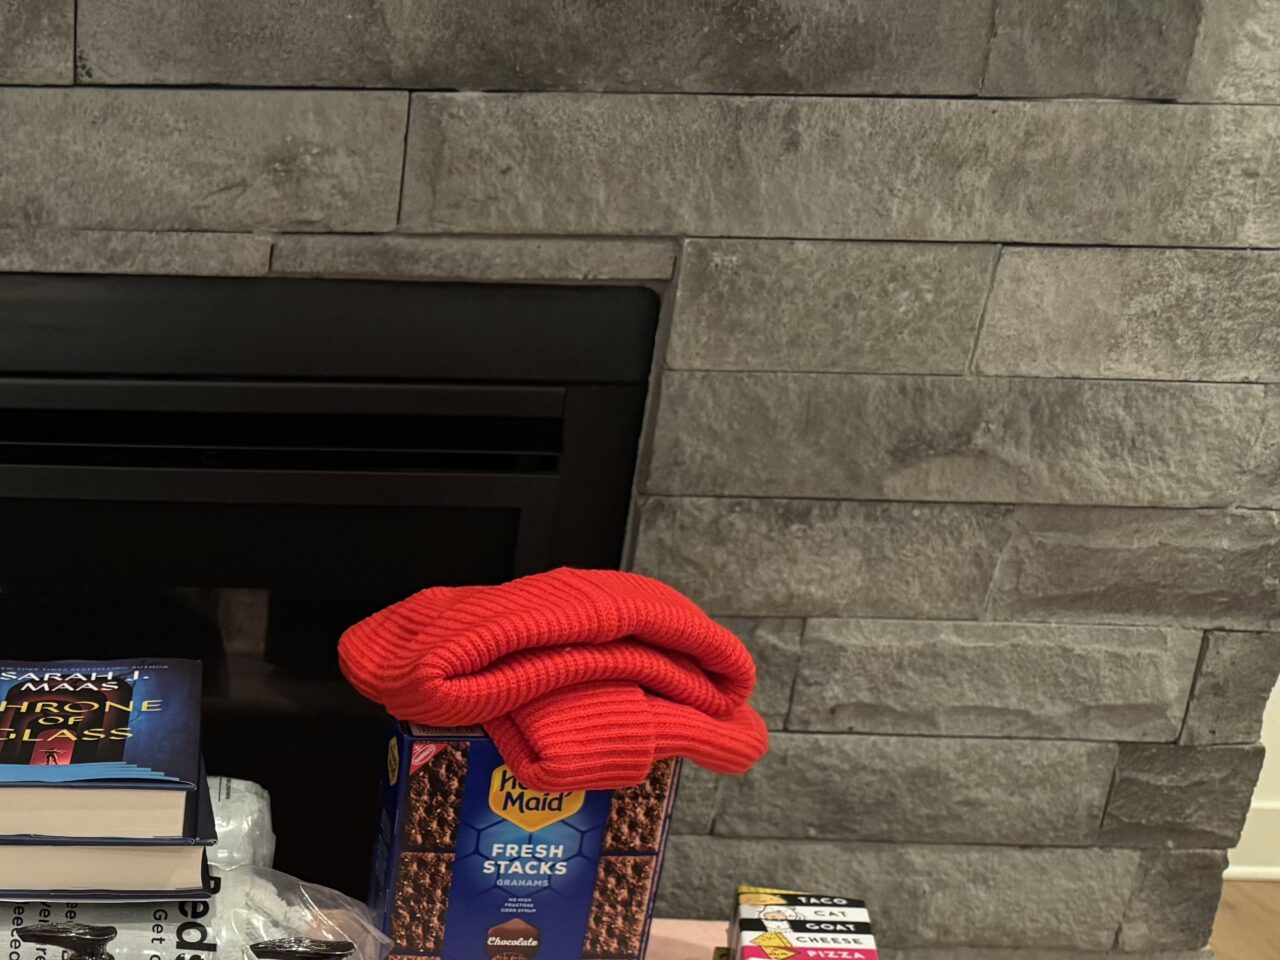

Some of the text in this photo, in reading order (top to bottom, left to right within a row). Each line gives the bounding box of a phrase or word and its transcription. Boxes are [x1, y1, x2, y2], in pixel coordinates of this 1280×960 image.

[0, 670, 150, 682] SARAH J.
[20, 682, 120, 692] MAAS
[38, 715, 86, 726] OF
[502, 791, 564, 813] Maid
[491, 844, 564, 858] FRESH
[482, 861, 568, 875] STACKS
[496, 879, 549, 887] GRAHAMS
[797, 897, 848, 905] TACO
[152, 909, 168, 945] Get
[805, 923, 856, 931] GOAT
[487, 937, 539, 946] Chocolate
[795, 936, 864, 945] CHEESE
[806, 950, 866, 959] PIZZA
